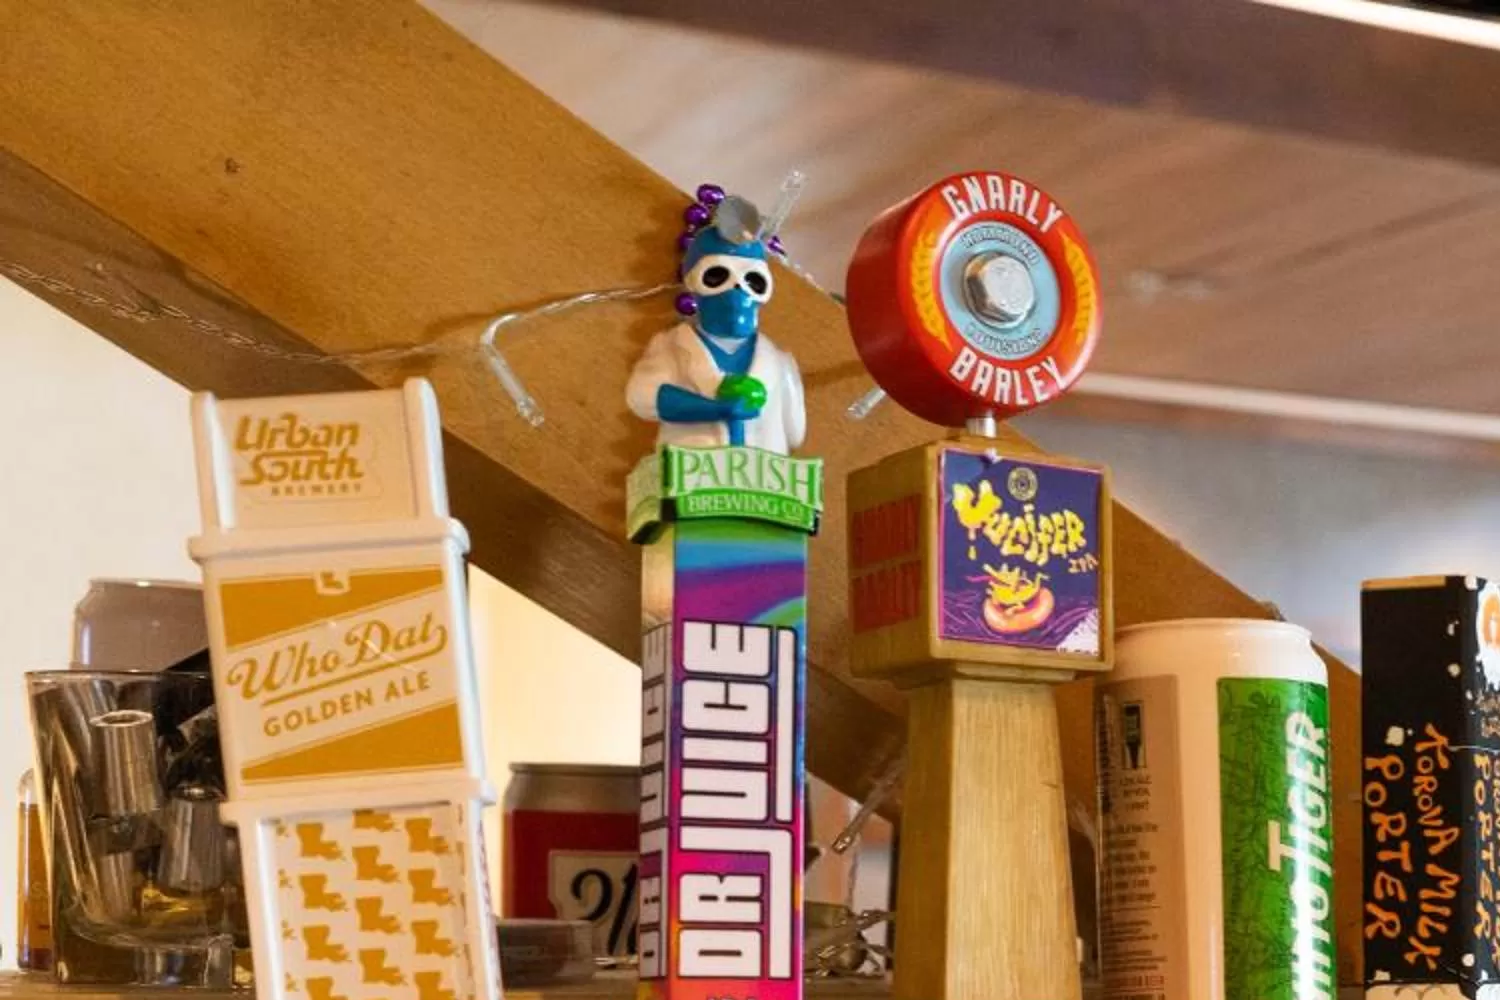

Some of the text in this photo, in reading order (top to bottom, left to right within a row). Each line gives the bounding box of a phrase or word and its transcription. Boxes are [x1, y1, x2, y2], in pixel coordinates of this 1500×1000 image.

[941, 175, 1063, 233] GNARLY
[949, 346, 1072, 406] BARLEY
[235, 413, 361, 451] Urban
[239, 450, 364, 485] South
[271, 483, 363, 497] BREWERY
[672, 448, 822, 507] PARISH
[688, 495, 778, 515] BREWING
[226, 612, 448, 699] Who Dat
[263, 671, 431, 737] GOLDEN ALE
[1364, 755, 1413, 943] PORTER
[1404, 723, 1461, 977] KOROVA MILK
[1474, 752, 1495, 939] PORTER
